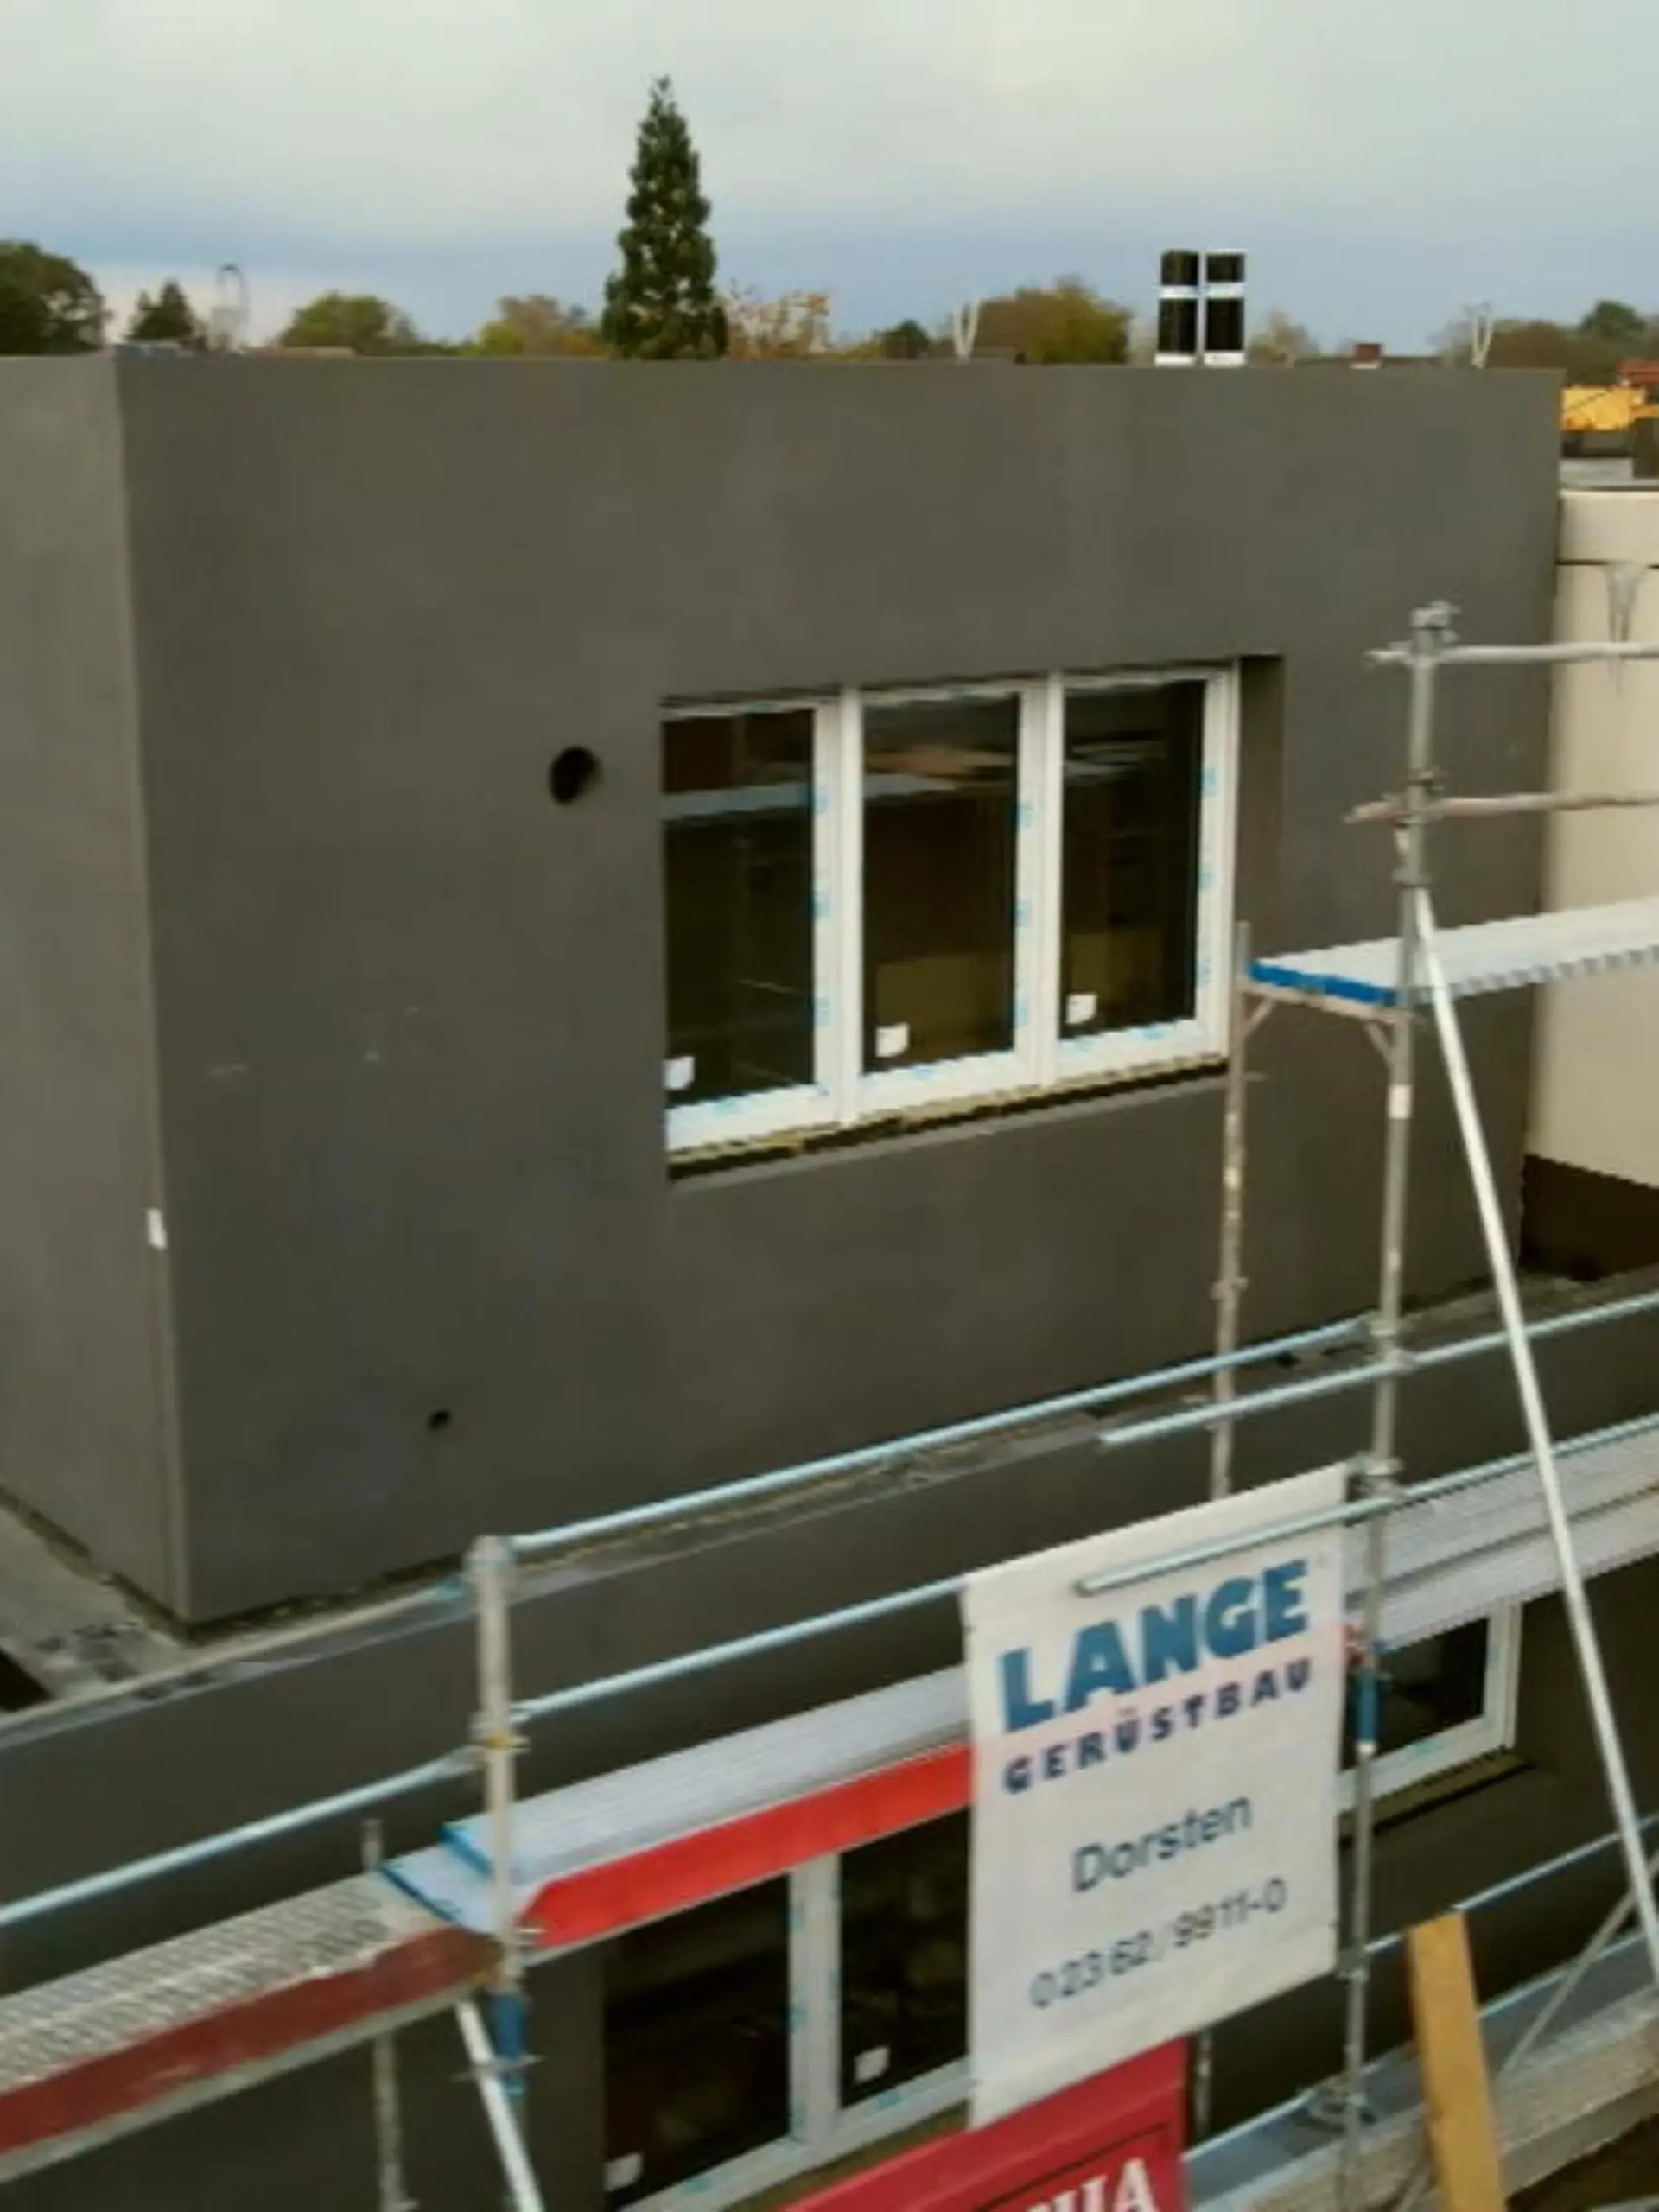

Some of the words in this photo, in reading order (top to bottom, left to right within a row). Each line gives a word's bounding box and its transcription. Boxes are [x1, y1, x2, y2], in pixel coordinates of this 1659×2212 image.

[998, 1560, 1309, 1733] LANGE
[1003, 1658, 1312, 1794] GERÜSTBAU
[1072, 1796, 1253, 1892] Dorsten
